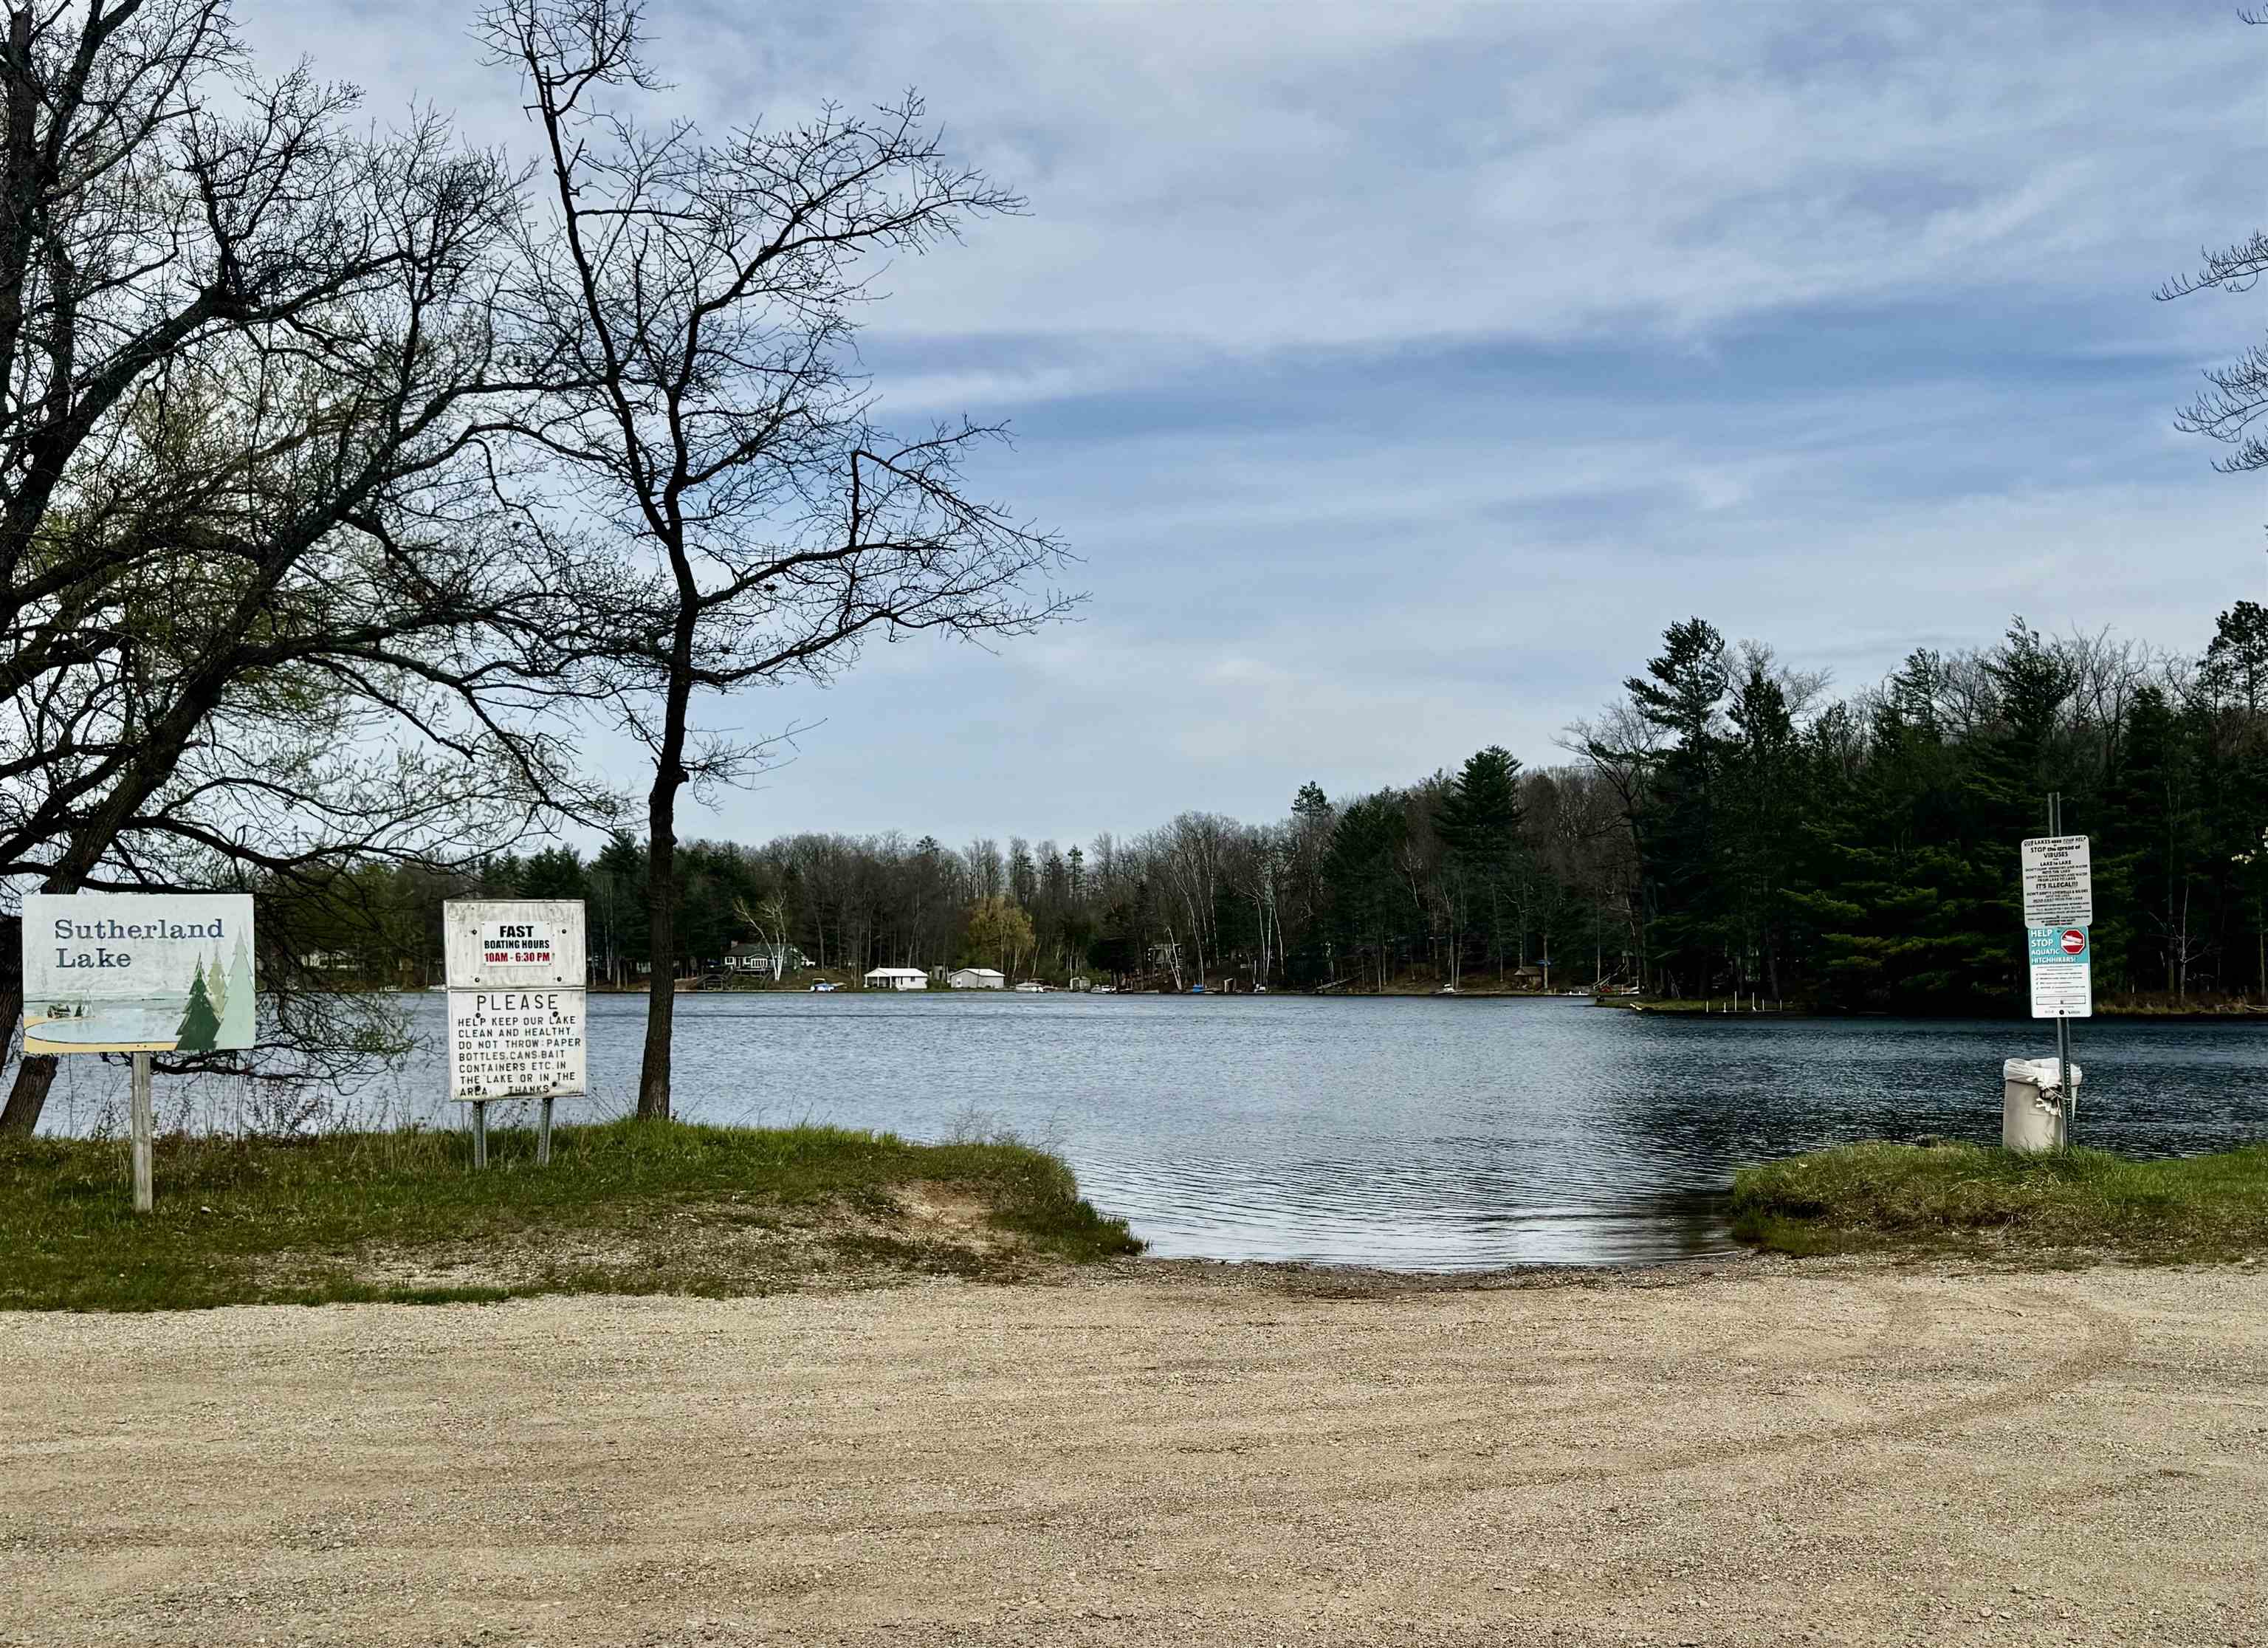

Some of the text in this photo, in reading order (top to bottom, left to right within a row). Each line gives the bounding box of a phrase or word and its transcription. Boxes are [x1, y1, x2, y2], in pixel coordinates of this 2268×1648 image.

[55, 919, 224, 940] Sutherland
[500, 926, 534, 938] FAST
[484, 939, 550, 950] BOATING HOURS
[56, 948, 131, 969] Lake
[484, 953, 509, 962] 10AM
[515, 952, 535, 962] 6:30
[537, 952, 550, 961] PM
[477, 995, 558, 1011] PLEASE
[458, 1016, 576, 1026] HELP KEEP OUR LAKE
[458, 1029, 492, 1038] CLEAN
[499, 1029, 519, 1037] AND
[458, 1041, 472, 1049] DO
[478, 1040, 498, 1048] NOT
[459, 1063, 526, 1073] CONTAINERS
[461, 1072, 575, 1085] THE LAKE OR IN THE
[508, 1085, 550, 1095] THANKS
